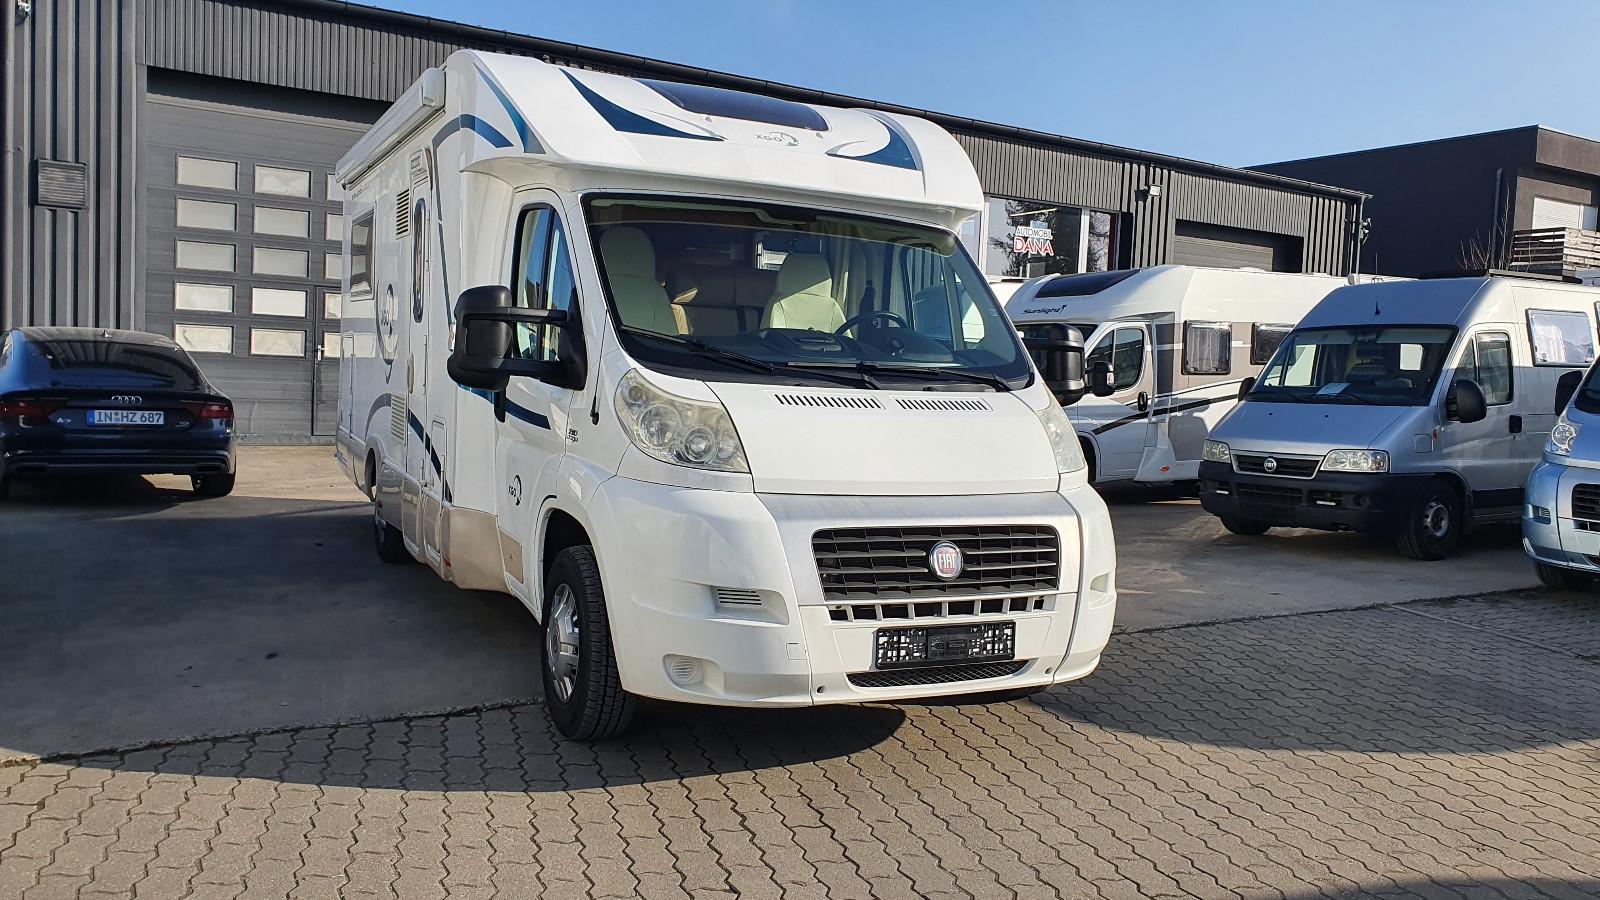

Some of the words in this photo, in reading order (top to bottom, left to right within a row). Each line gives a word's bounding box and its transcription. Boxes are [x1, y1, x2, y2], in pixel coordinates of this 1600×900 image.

[1016, 226, 1053, 239] AUTOMOBIL
[1014, 236, 1054, 256] DANA
[139, 412, 162, 423] 687
[938, 553, 956, 570] FIAT
